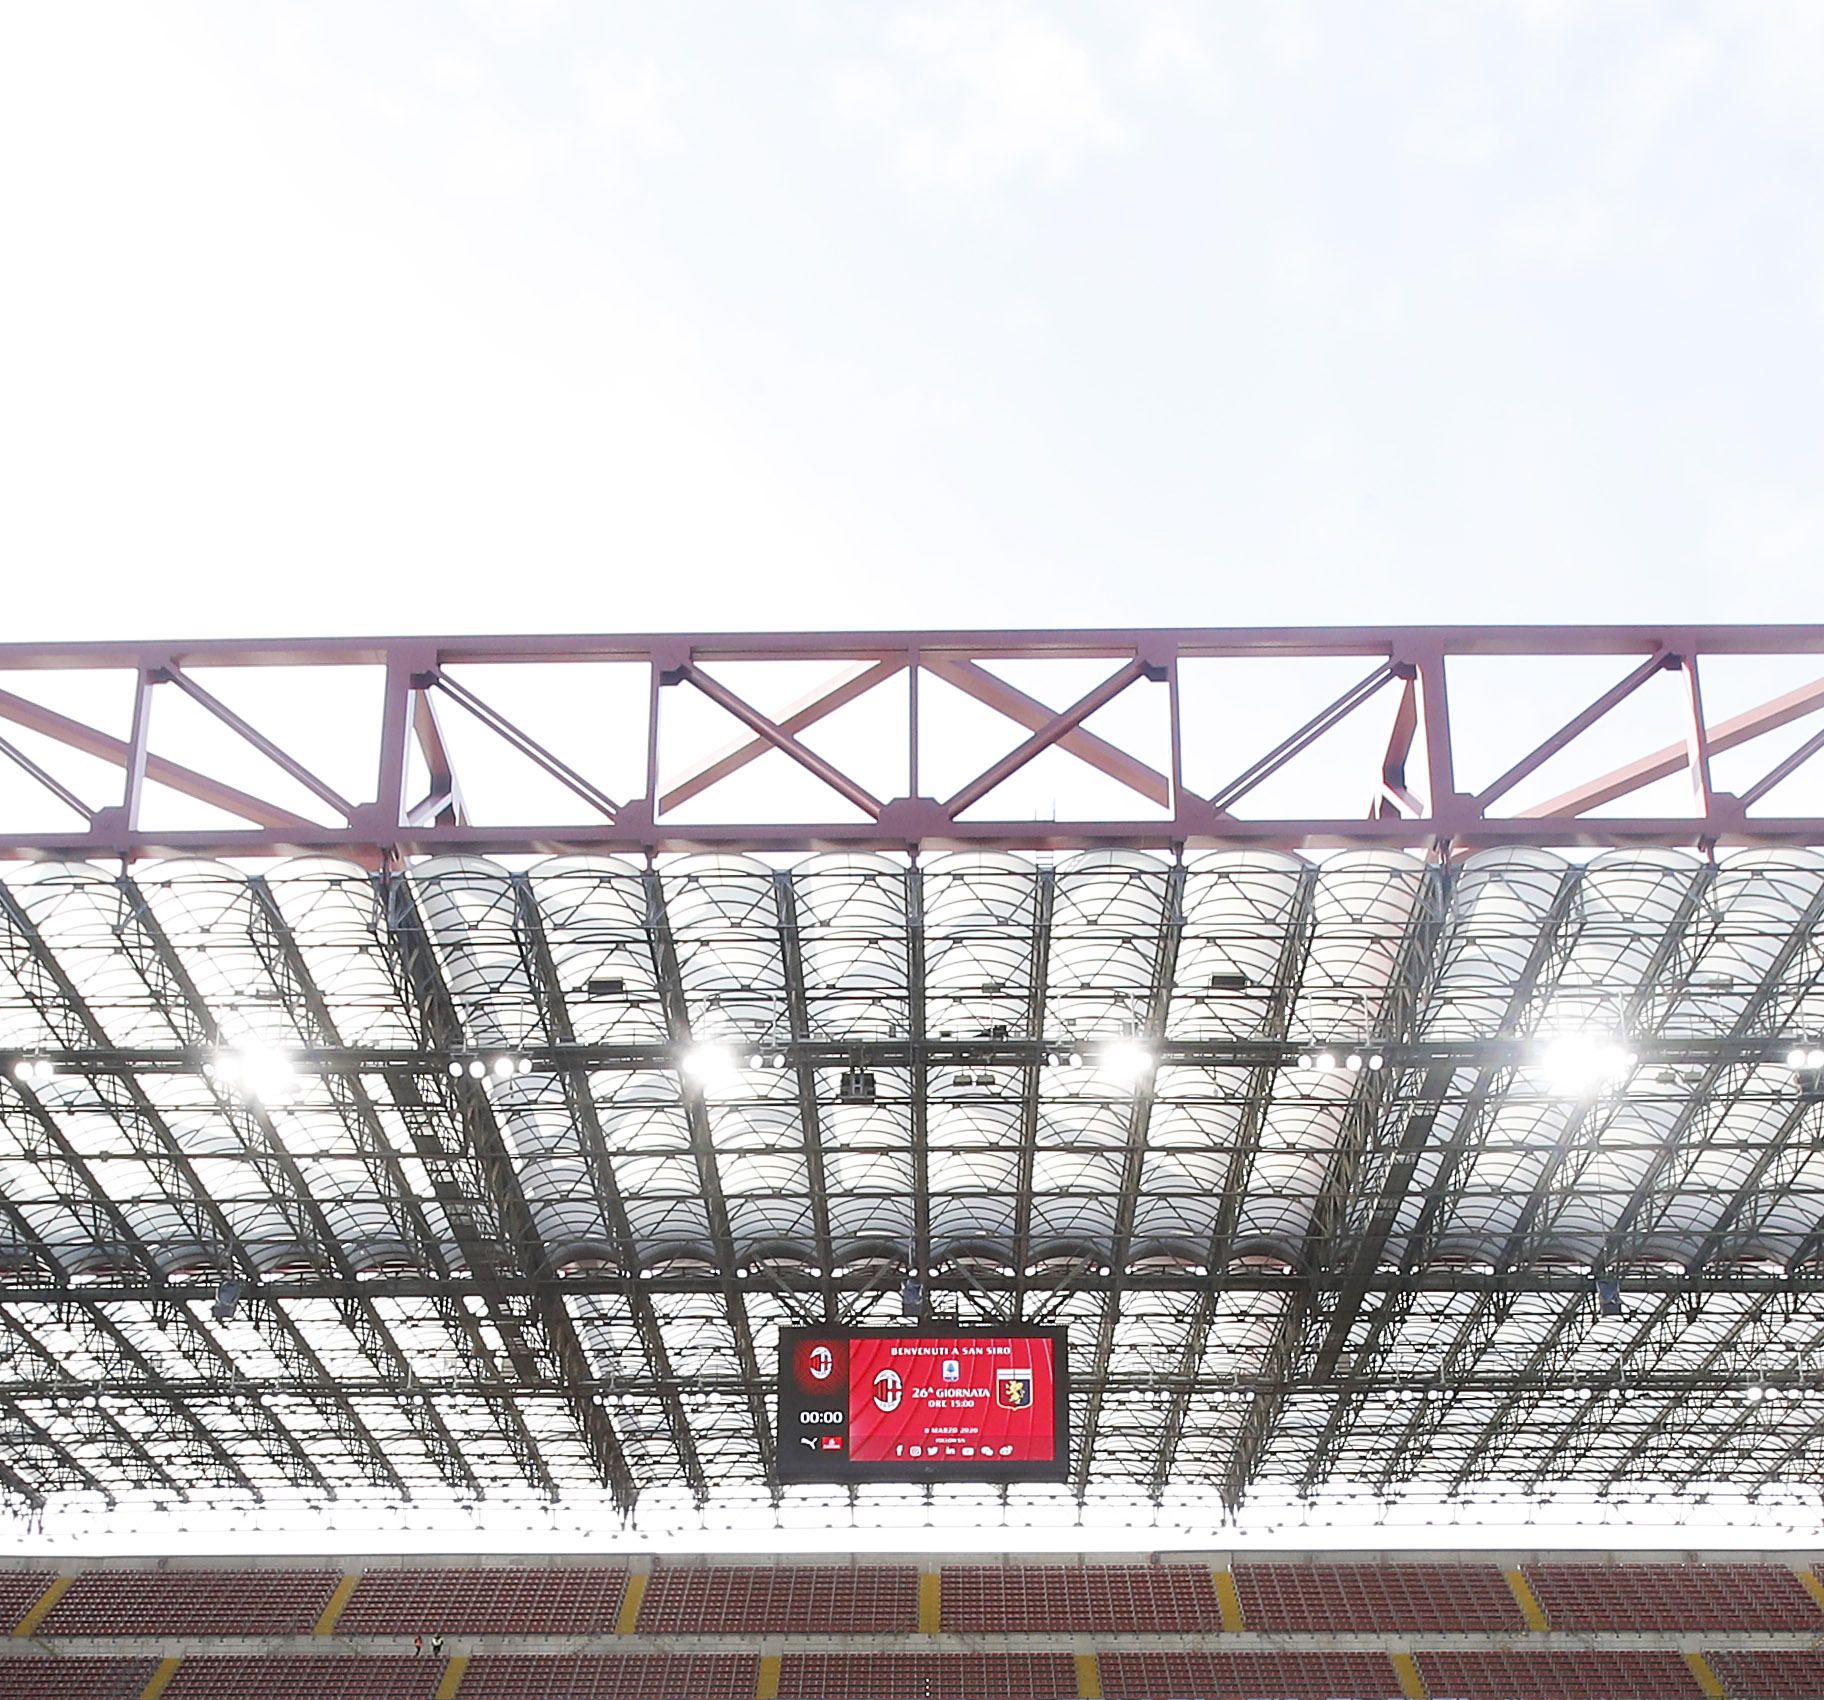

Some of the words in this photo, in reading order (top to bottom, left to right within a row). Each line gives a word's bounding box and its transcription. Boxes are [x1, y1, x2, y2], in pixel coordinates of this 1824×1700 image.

[891, 1347, 949, 1356] BENVENUTI
[951, 1347, 960, 1355] A
[962, 1347, 983, 1355] SAN
[986, 1347, 1012, 1355] SIRO
[936, 1388, 991, 1398] GIORNATA
[928, 1400, 947, 1408] ORE
[950, 1400, 975, 1408] 15:00
[800, 1411, 843, 1424] 00:00
